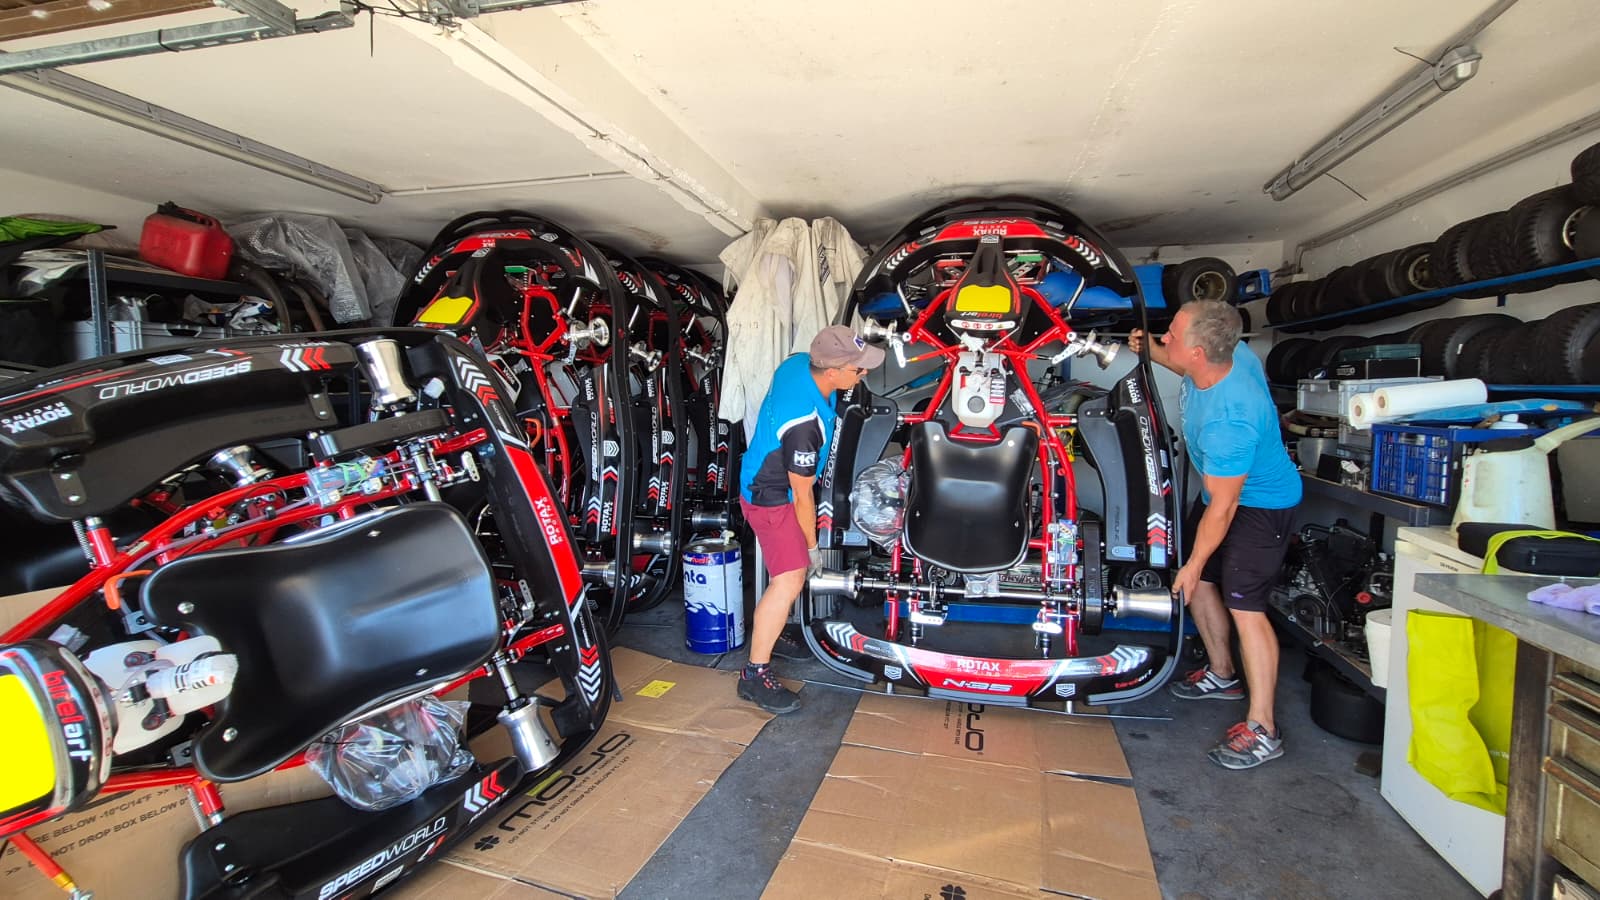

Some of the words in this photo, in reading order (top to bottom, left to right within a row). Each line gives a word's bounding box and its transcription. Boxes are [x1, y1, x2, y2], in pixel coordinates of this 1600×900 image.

[99, 361, 252, 400] SPEEDWORLD
[4, 406, 72, 434] ROTAX
[1139, 415, 1159, 496] SPEEDWORLD
[535, 499, 559, 545] ROTAX
[601, 501, 610, 532] ROTAX
[957, 659, 1000, 671] ROTAX
[42, 670, 94, 761] birelart
[53, 814, 97, 838] BELOW
[78, 828, 111, 847] DROP
[113, 817, 138, 833] BOX
[140, 803, 177, 823] BELOW
[318, 816, 447, 900] SPEEDWORLD
